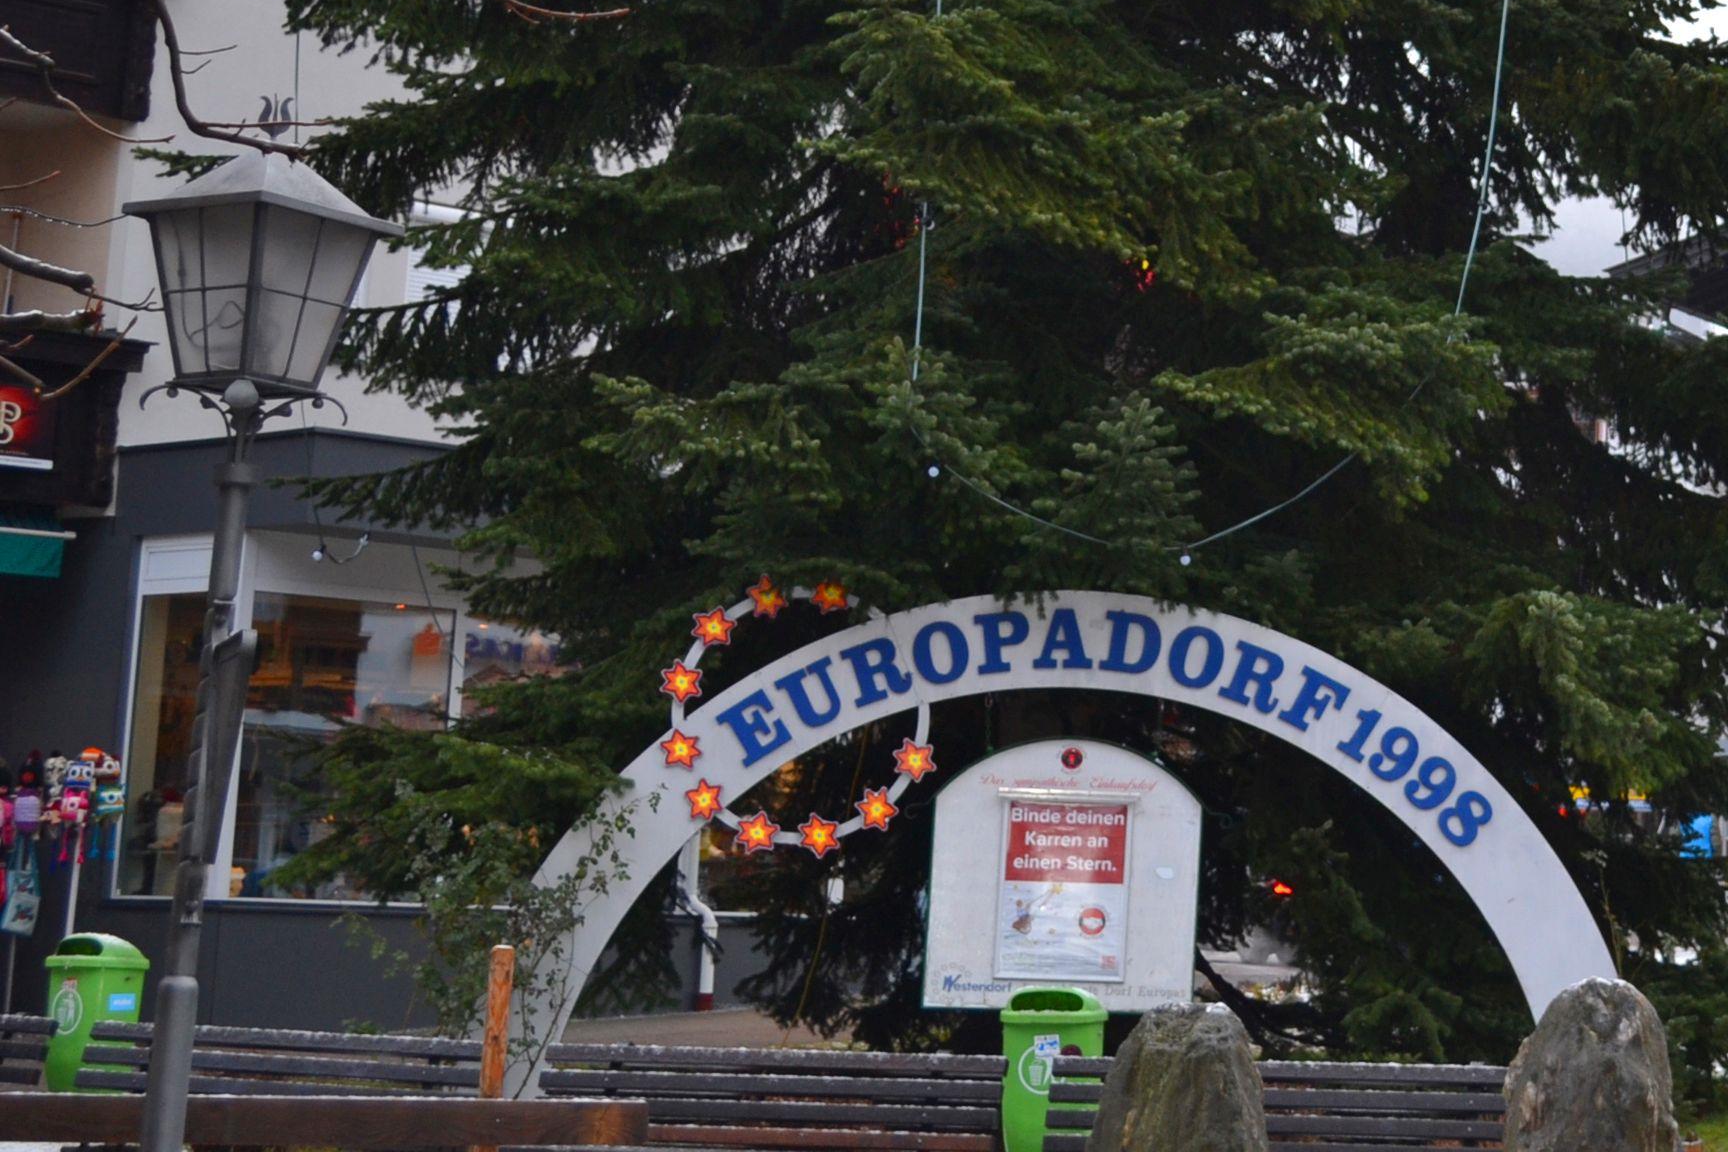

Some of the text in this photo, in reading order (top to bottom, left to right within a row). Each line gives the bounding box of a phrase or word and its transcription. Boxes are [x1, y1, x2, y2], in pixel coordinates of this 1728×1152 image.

[716, 608, 1494, 848] EUROPADORF 1998
[1011, 808, 1125, 825] Binde deinen
[1025, 831, 1109, 848] Karren an
[1013, 854, 1117, 872] einen Stern.
[943, 974, 1012, 992] Westendorf
